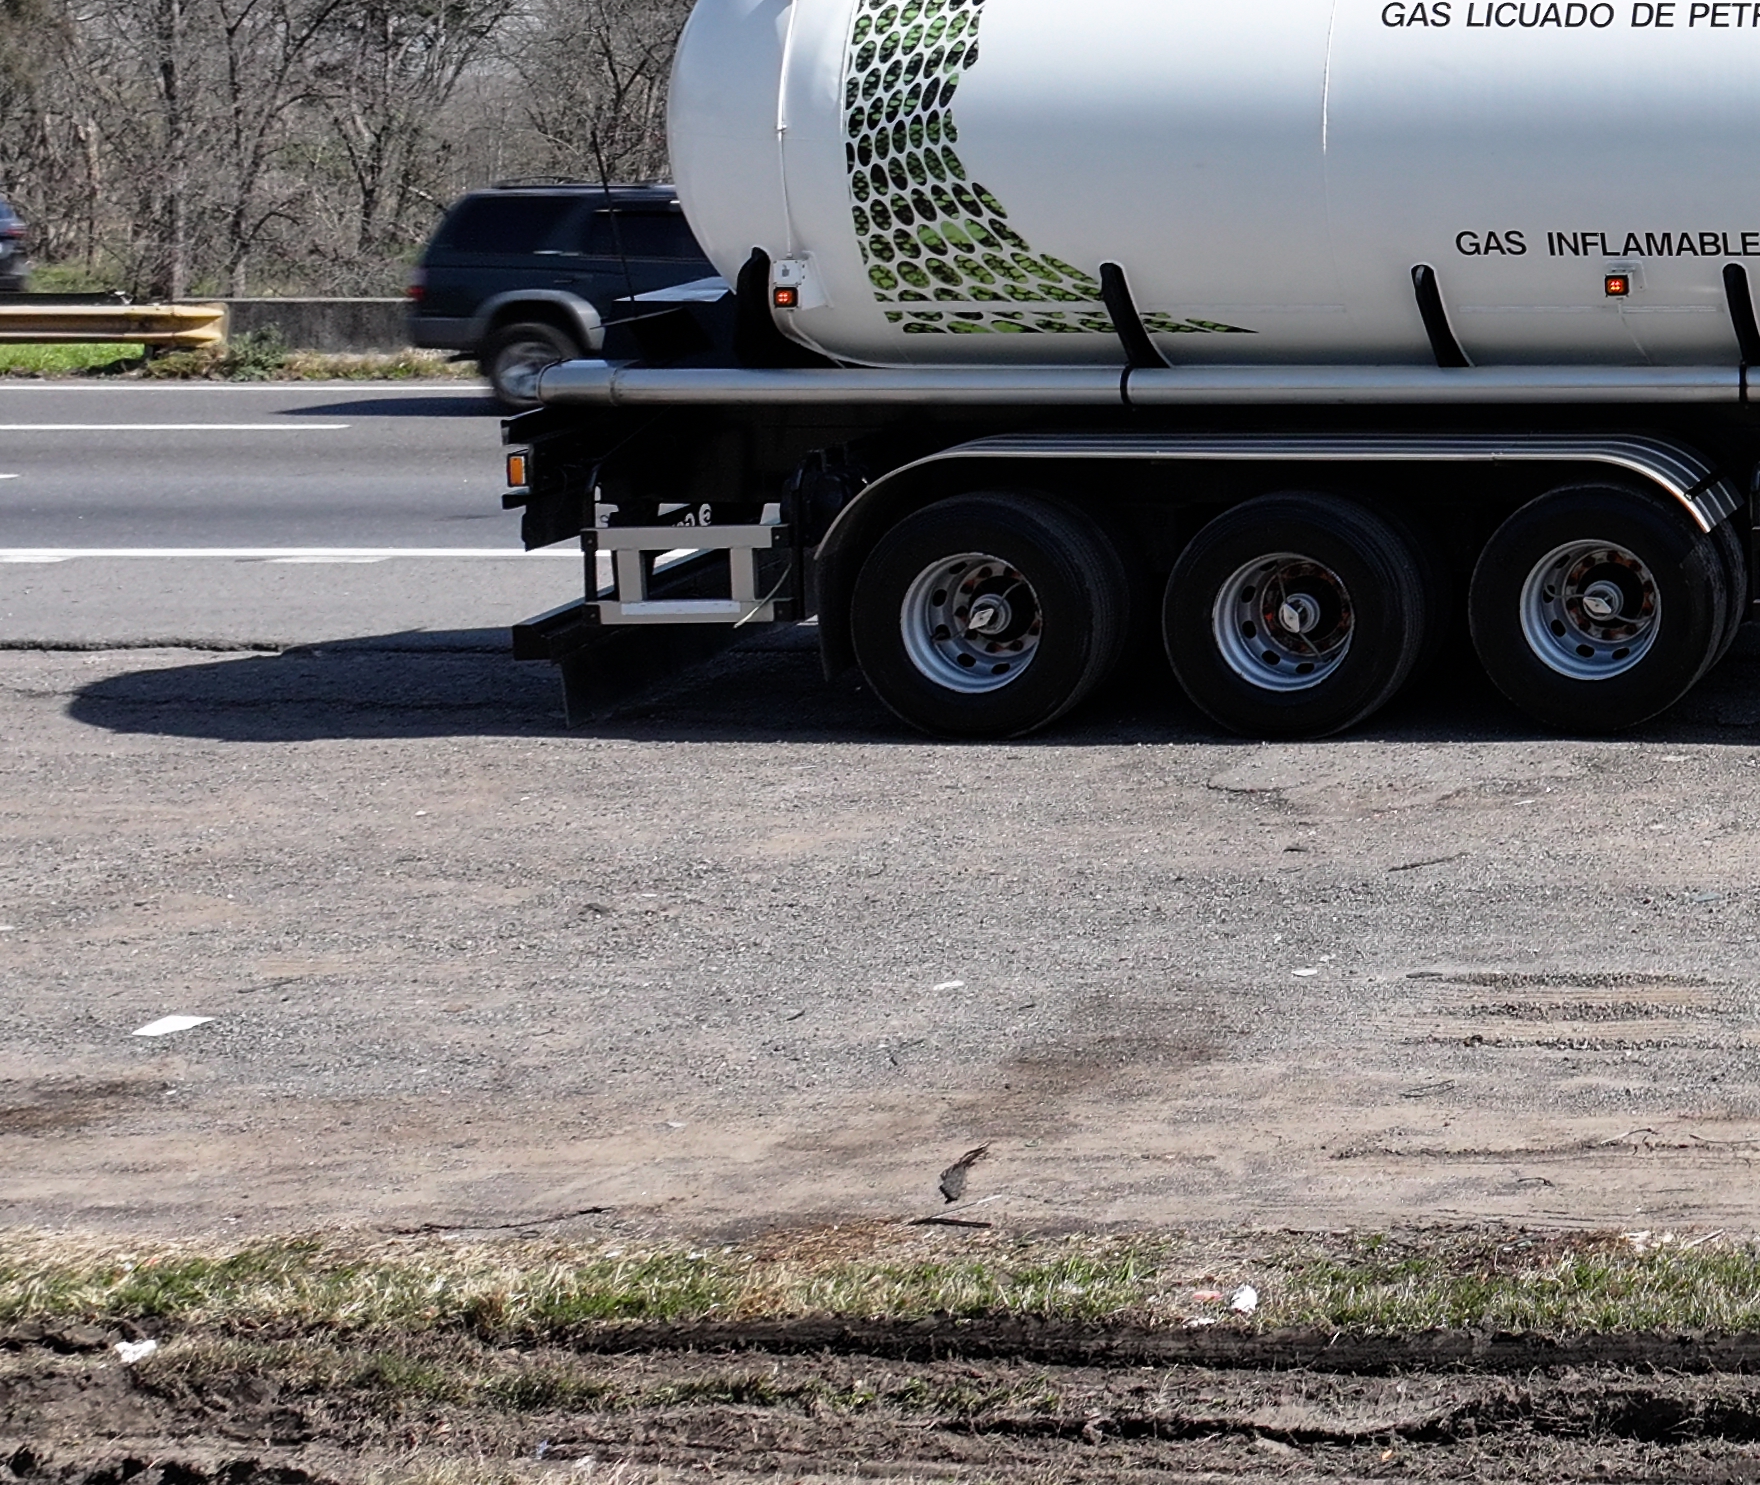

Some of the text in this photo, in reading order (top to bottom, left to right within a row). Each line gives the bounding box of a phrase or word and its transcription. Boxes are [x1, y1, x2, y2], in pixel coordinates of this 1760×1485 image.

[1381, 1, 1452, 28] GAS
[1466, 2, 1615, 28] LICUADO
[1631, 2, 1676, 28] DE
[1455, 230, 1528, 256] GAS
